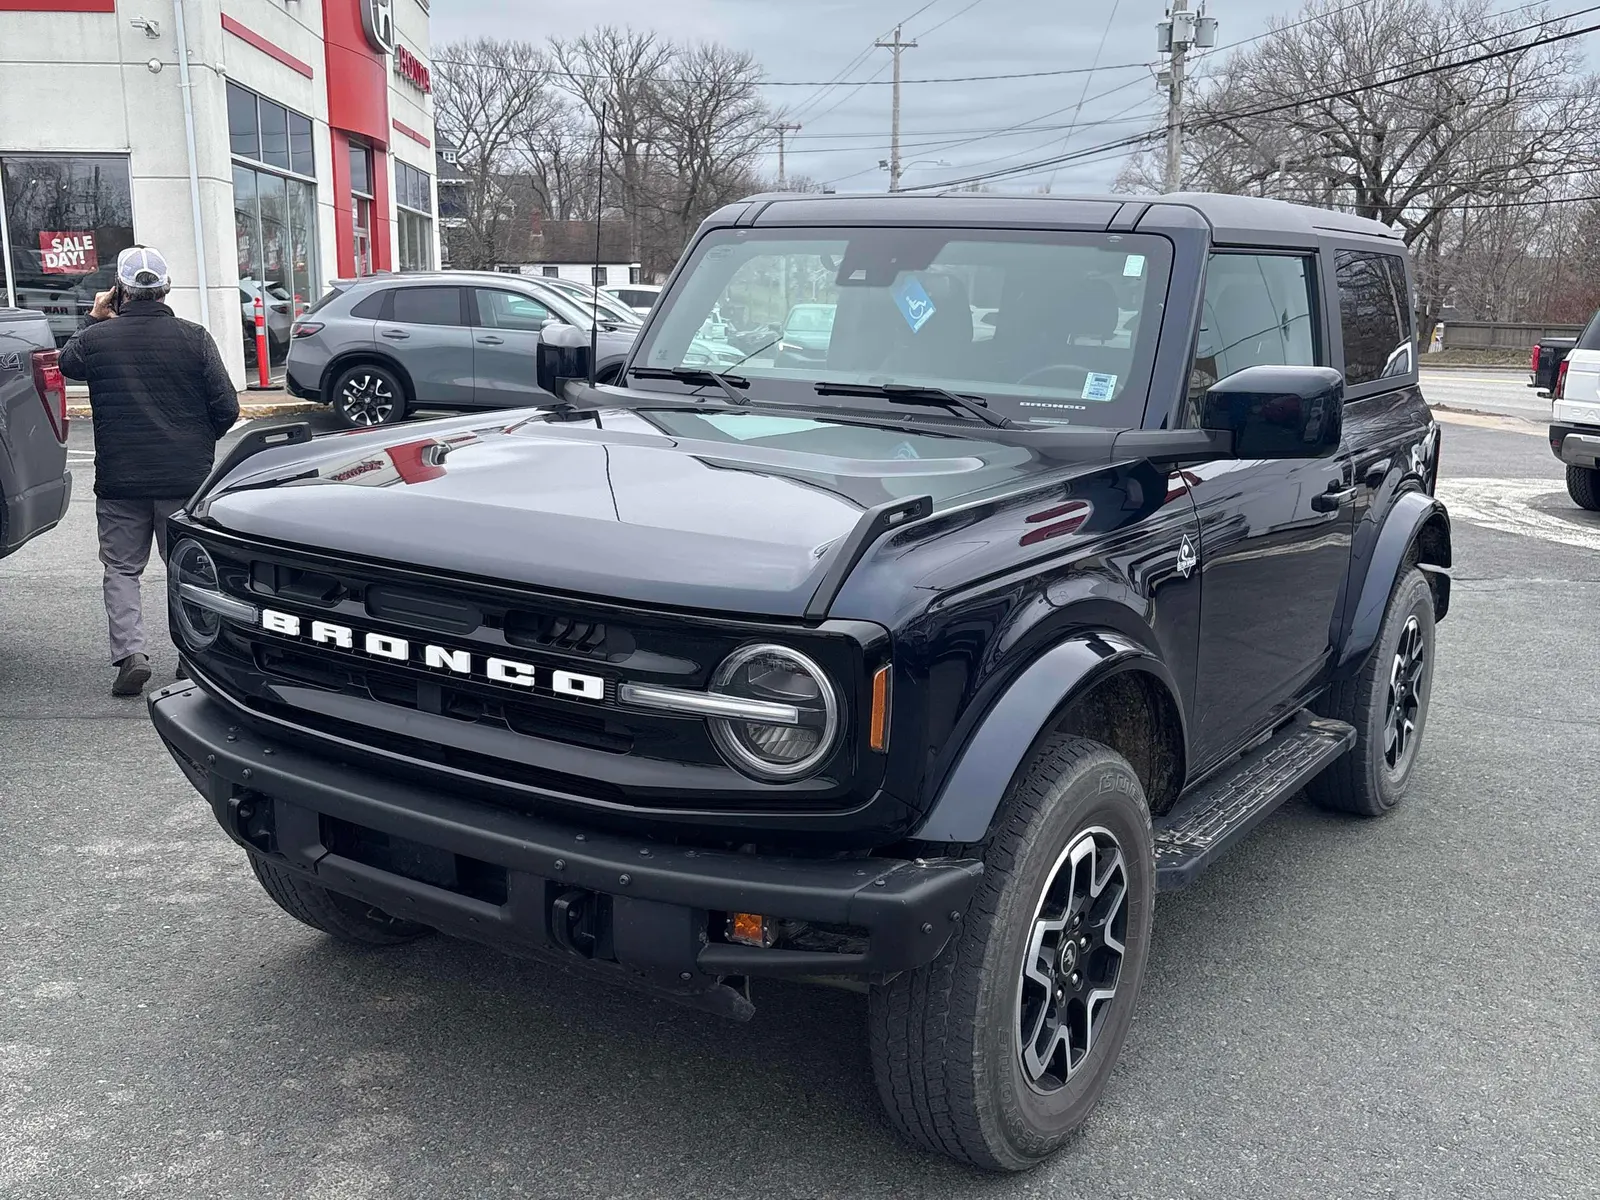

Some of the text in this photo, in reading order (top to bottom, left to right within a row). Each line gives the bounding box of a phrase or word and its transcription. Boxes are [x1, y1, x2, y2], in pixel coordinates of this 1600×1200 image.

[397, 44, 432, 94] HONDA
[45, 251, 86, 268] DAY!
[51, 235, 94, 254] SALE
[262, 608, 605, 701] BRONCO
